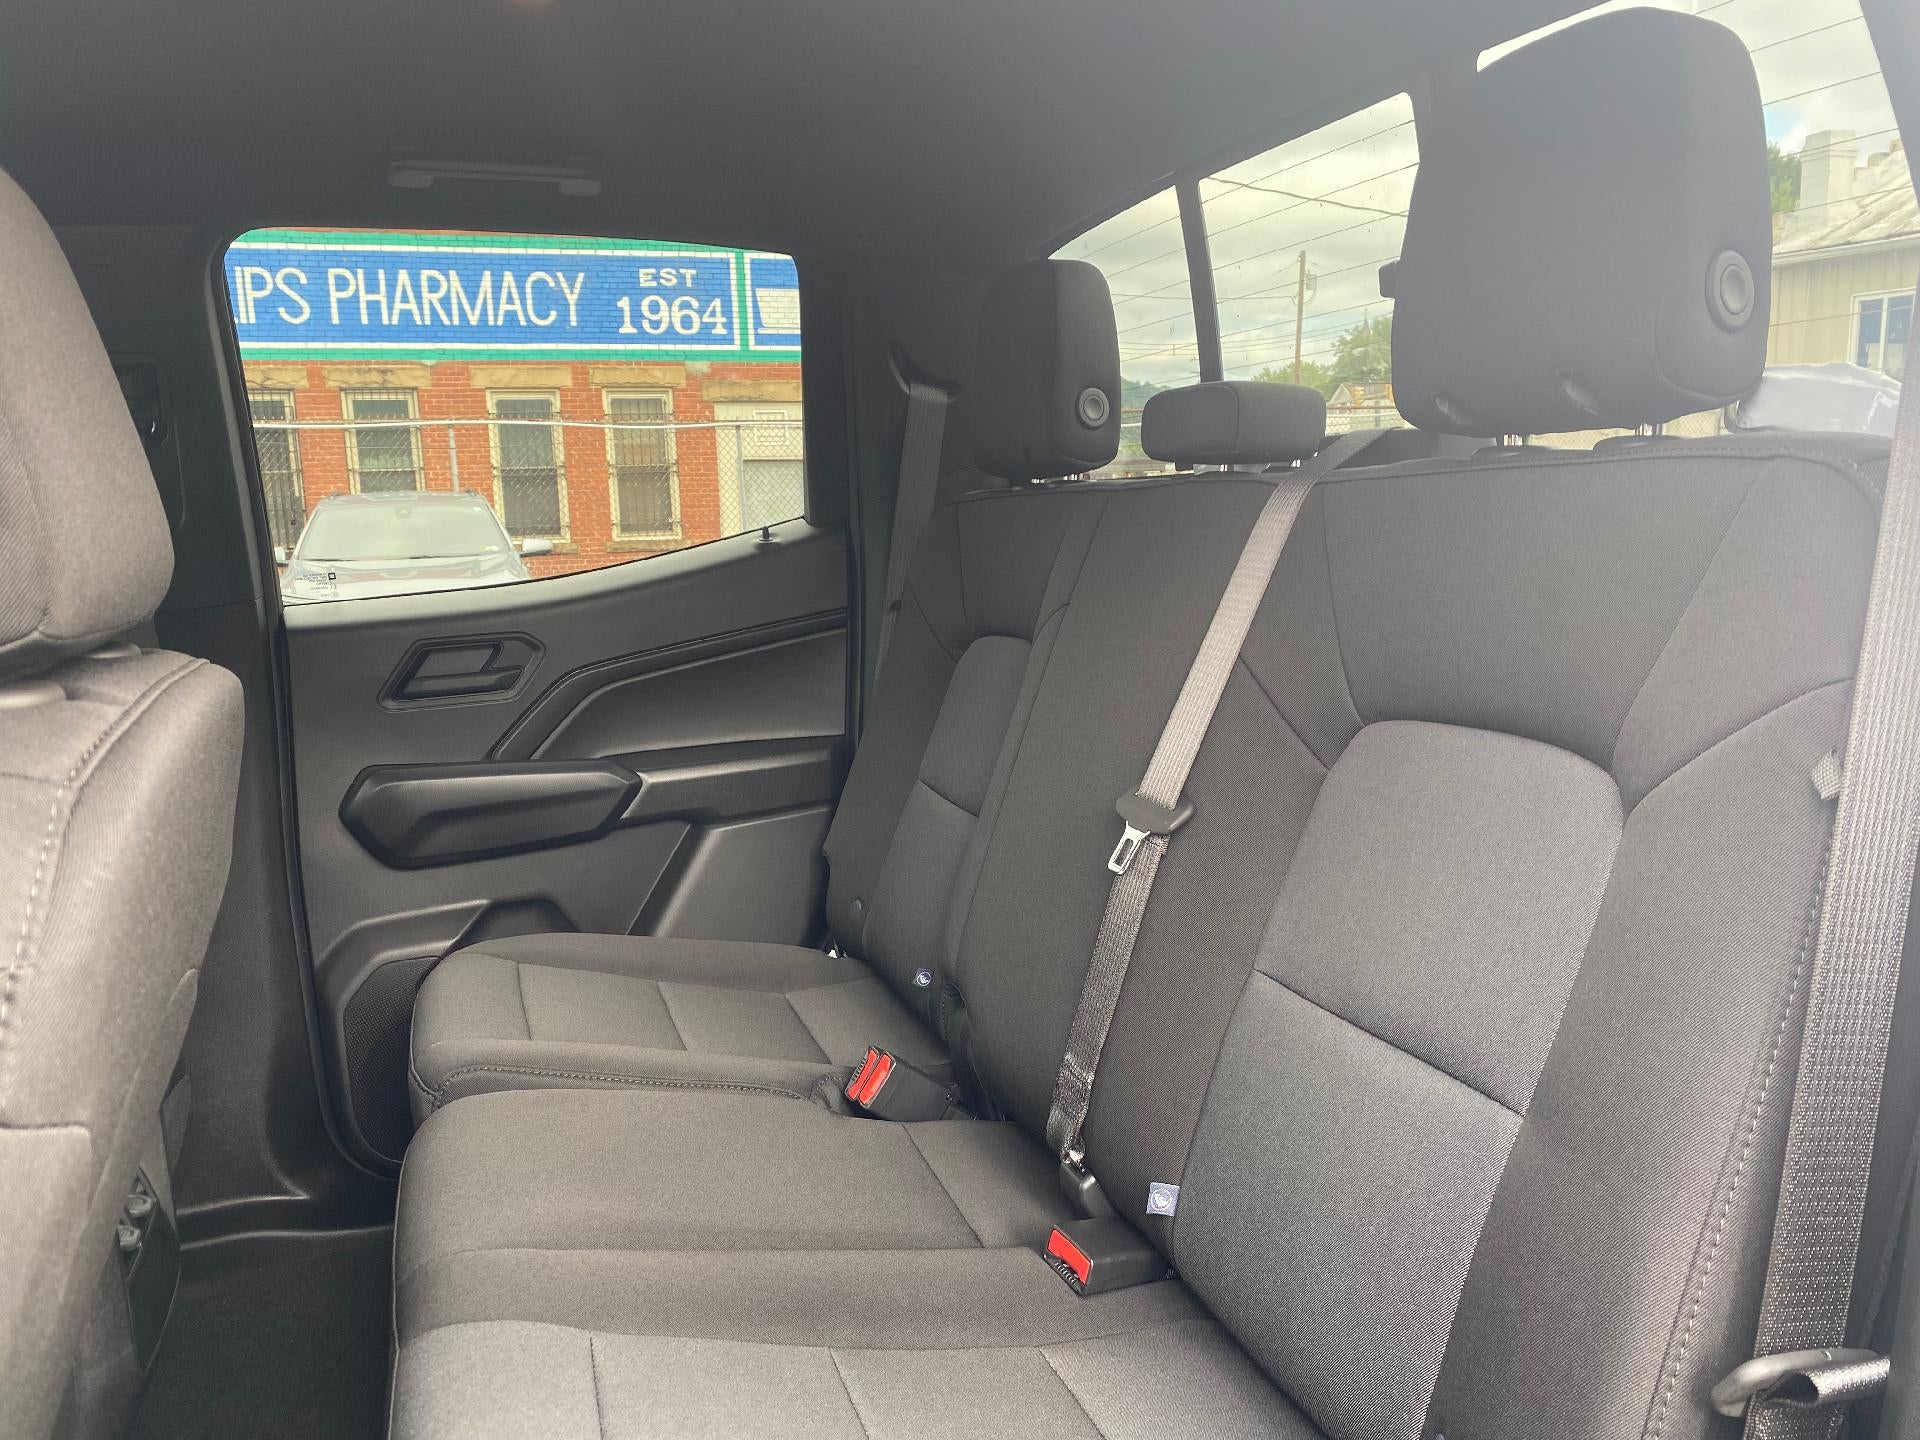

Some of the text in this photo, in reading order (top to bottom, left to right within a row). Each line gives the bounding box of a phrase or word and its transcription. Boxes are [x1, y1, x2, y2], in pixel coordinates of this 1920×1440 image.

[234, 266, 585, 327] IPS PHARMACY
[638, 267, 697, 288] EST
[616, 294, 728, 335] 1964
